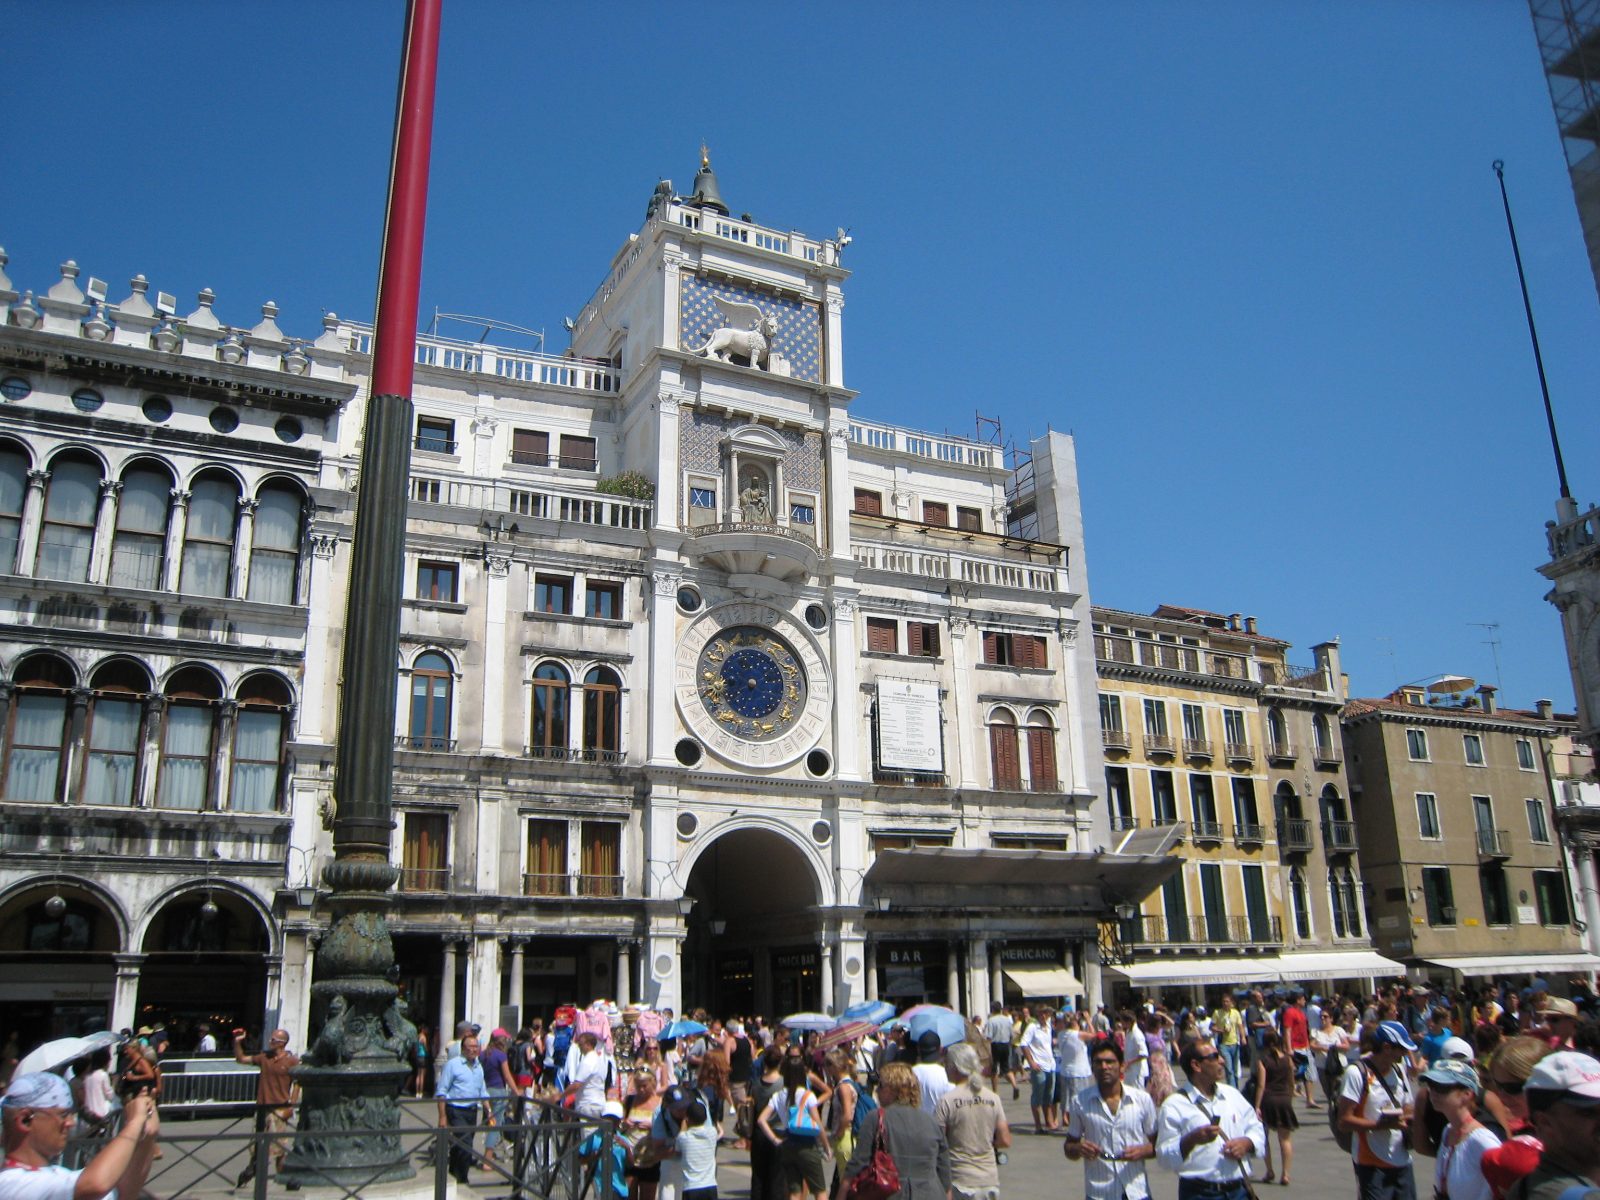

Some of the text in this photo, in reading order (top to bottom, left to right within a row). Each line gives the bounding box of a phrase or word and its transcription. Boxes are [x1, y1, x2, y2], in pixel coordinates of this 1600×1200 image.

[691, 488, 712, 508] XI
[791, 505, 814, 524] 40
[801, 954, 816, 966] BAR
[890, 950, 922, 962] BAR
[1001, 948, 1057, 961] MERICANO
